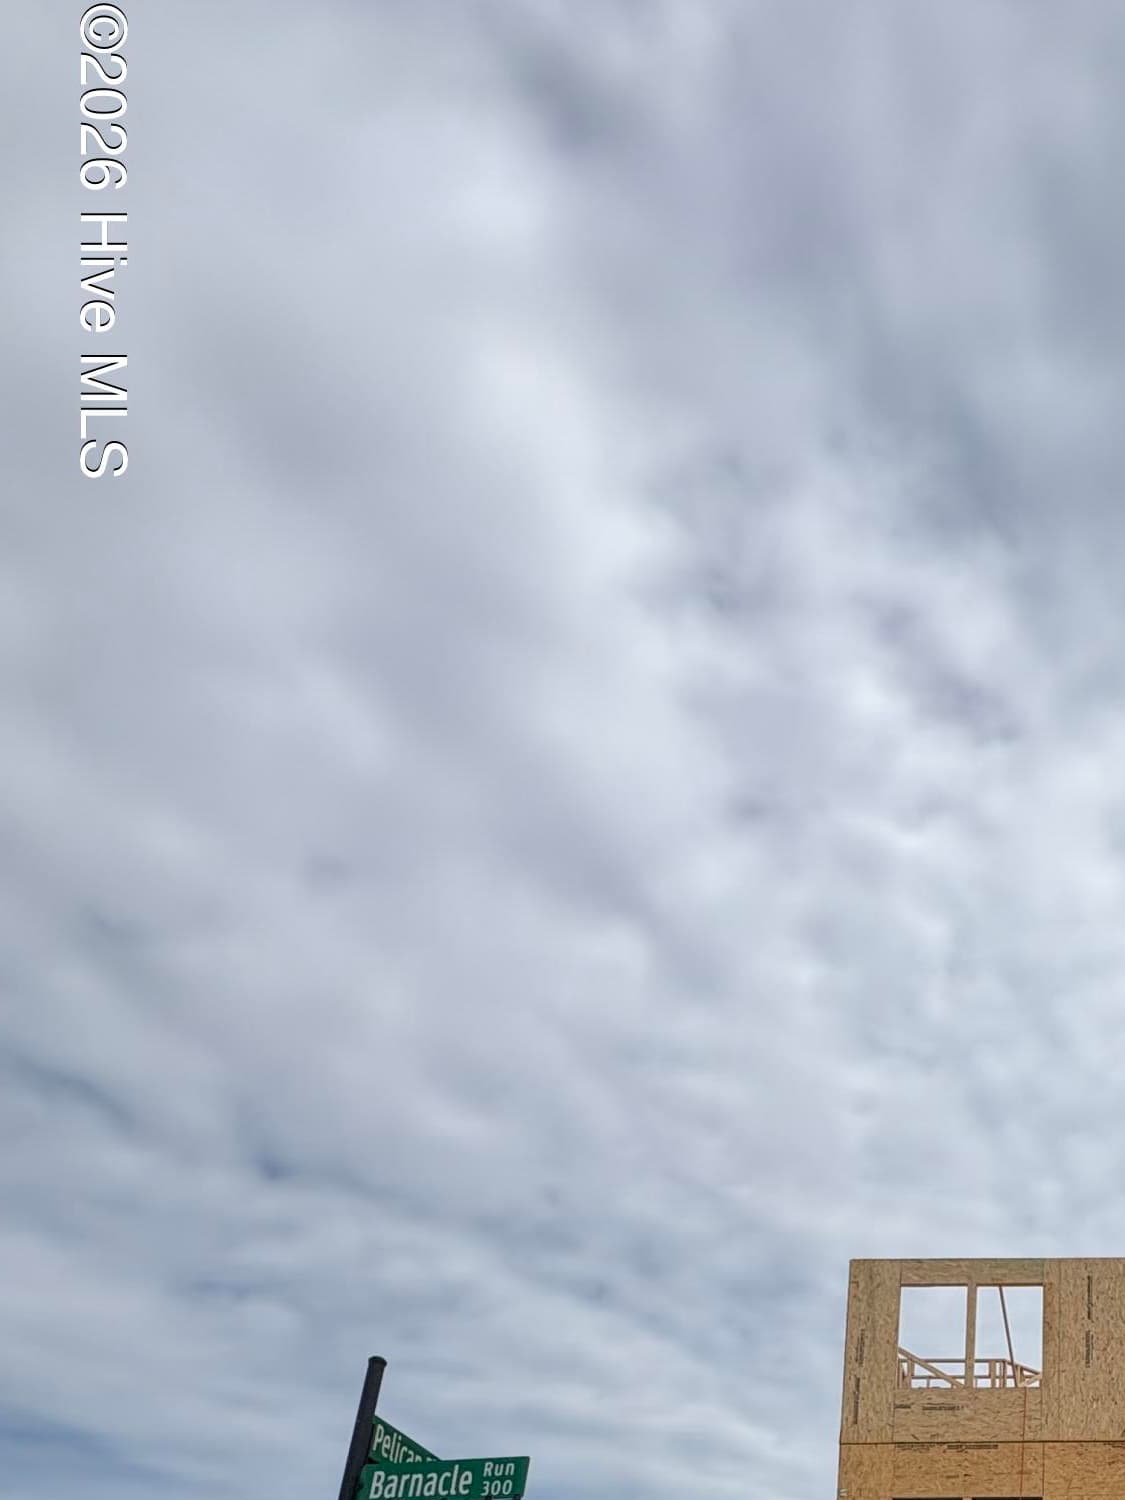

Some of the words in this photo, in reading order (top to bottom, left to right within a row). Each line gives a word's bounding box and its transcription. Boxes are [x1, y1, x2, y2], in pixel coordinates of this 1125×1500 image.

[369, 1464, 473, 1500] Barnacle
[483, 1461, 515, 1477] Run
[480, 1479, 513, 1496] 300
